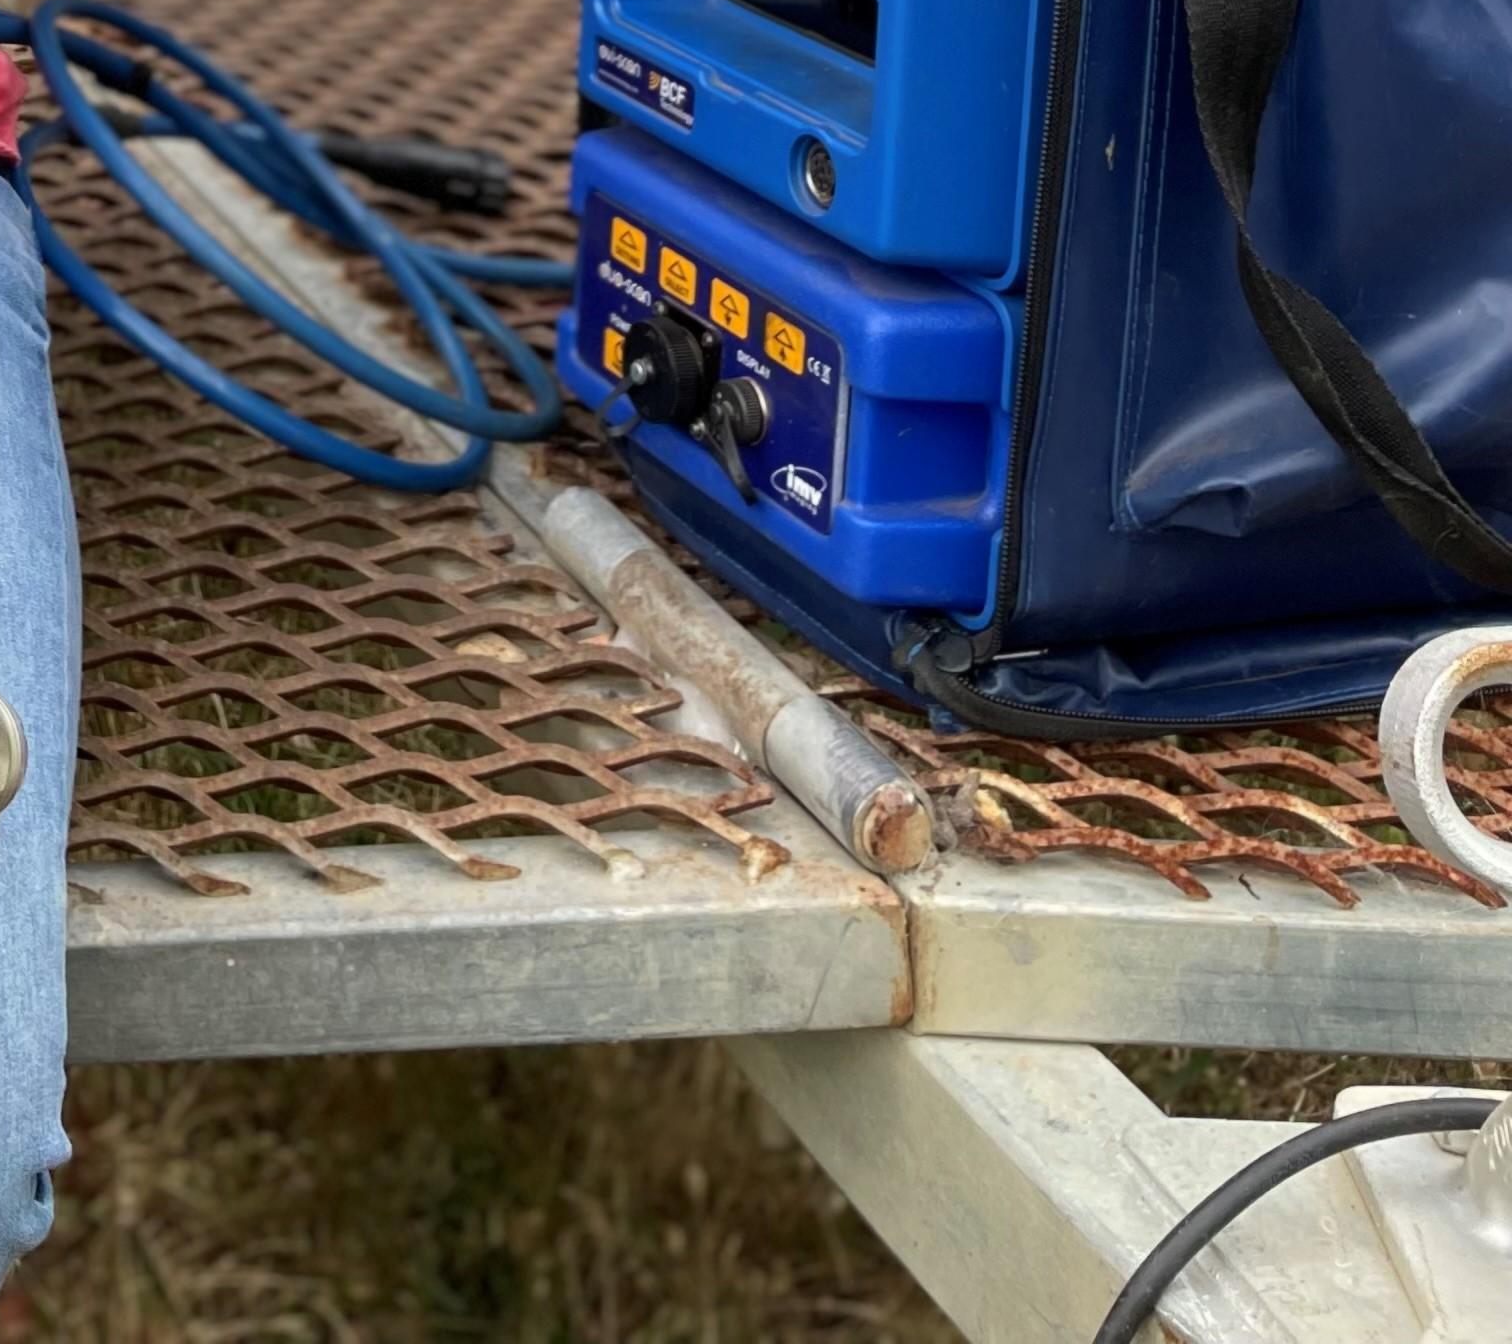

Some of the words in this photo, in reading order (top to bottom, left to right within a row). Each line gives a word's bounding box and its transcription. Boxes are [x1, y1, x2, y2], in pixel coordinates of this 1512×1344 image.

[659, 76, 687, 104] BCF
[737, 349, 770, 379] DISPLAY
[787, 463, 822, 506] imv
